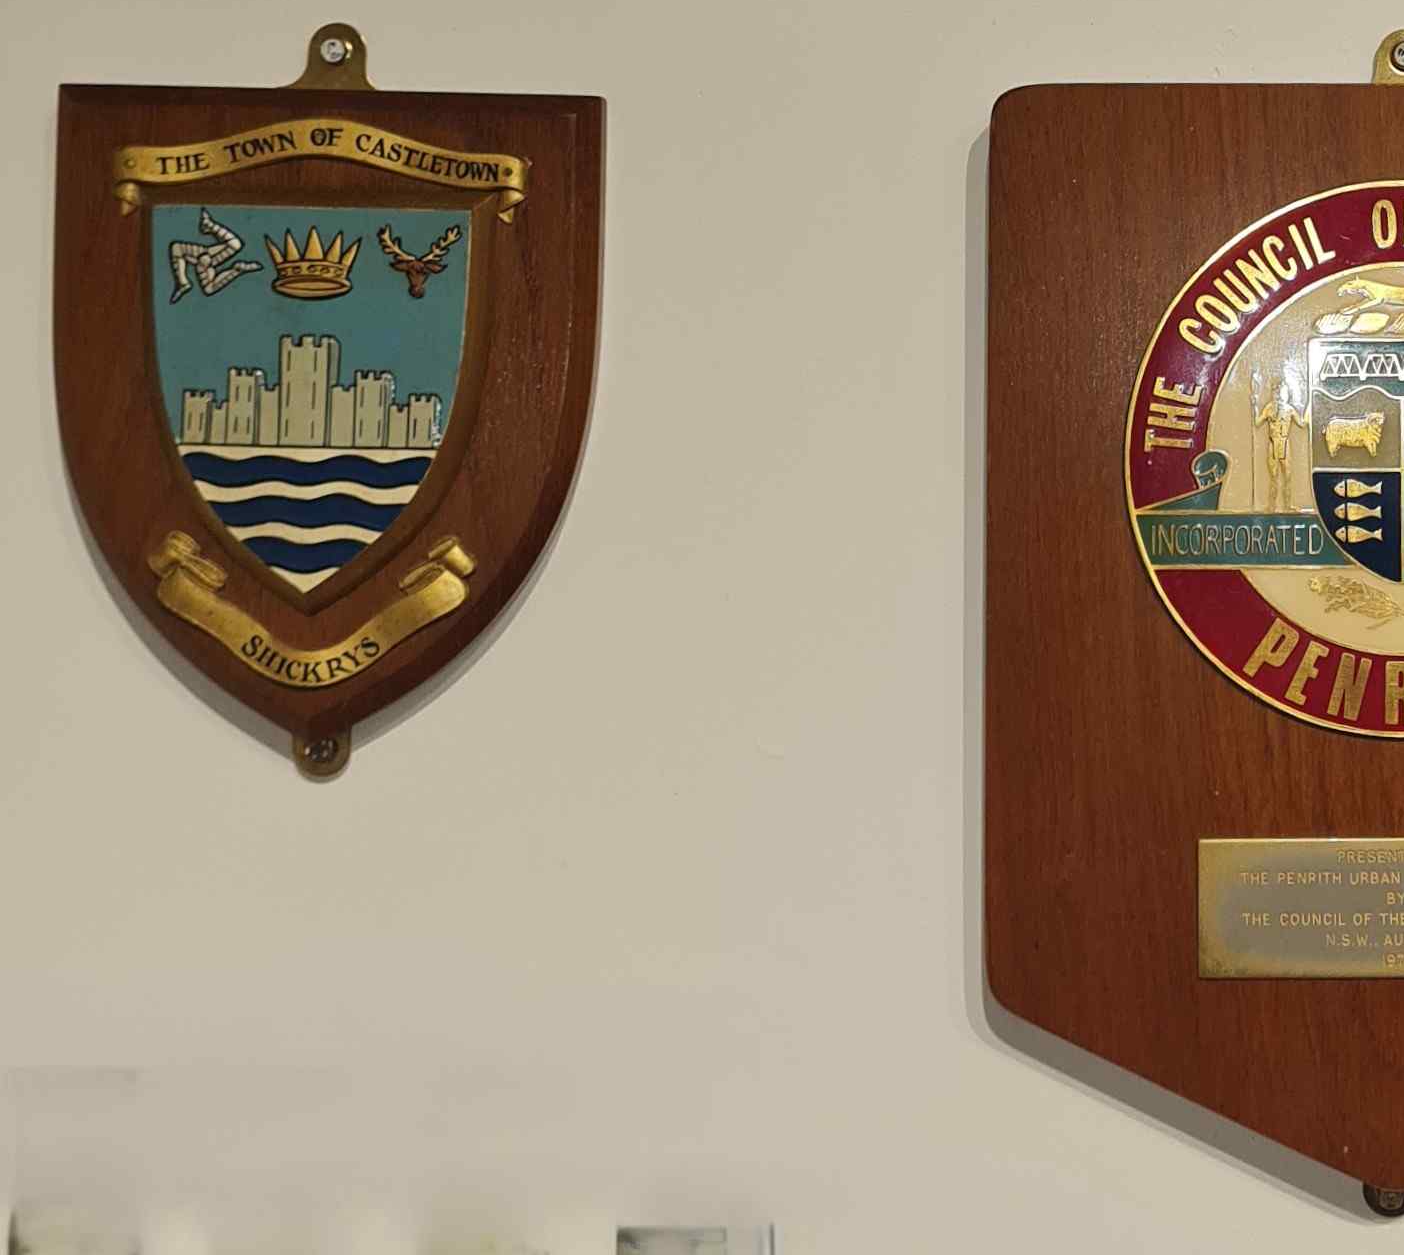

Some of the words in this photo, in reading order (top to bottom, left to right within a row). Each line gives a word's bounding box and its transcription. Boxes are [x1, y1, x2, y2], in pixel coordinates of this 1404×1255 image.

[157, 153, 210, 175] THE
[224, 130, 296, 163] TOWN
[310, 128, 343, 147] OF
[355, 134, 500, 183] CASTLETOWN
[1145, 376, 1202, 453] THE
[1178, 217, 1336, 354] COUNCIL
[1151, 523, 1325, 556] INCORPORATED
[1240, 872, 1269, 885] THE
[1277, 872, 1342, 885] PENRITH
[1349, 871, 1401, 885] URBAN
[1241, 912, 1271, 926] THE
[1279, 912, 1346, 926] COUNCIL
[1352, 912, 1371, 926] OF
